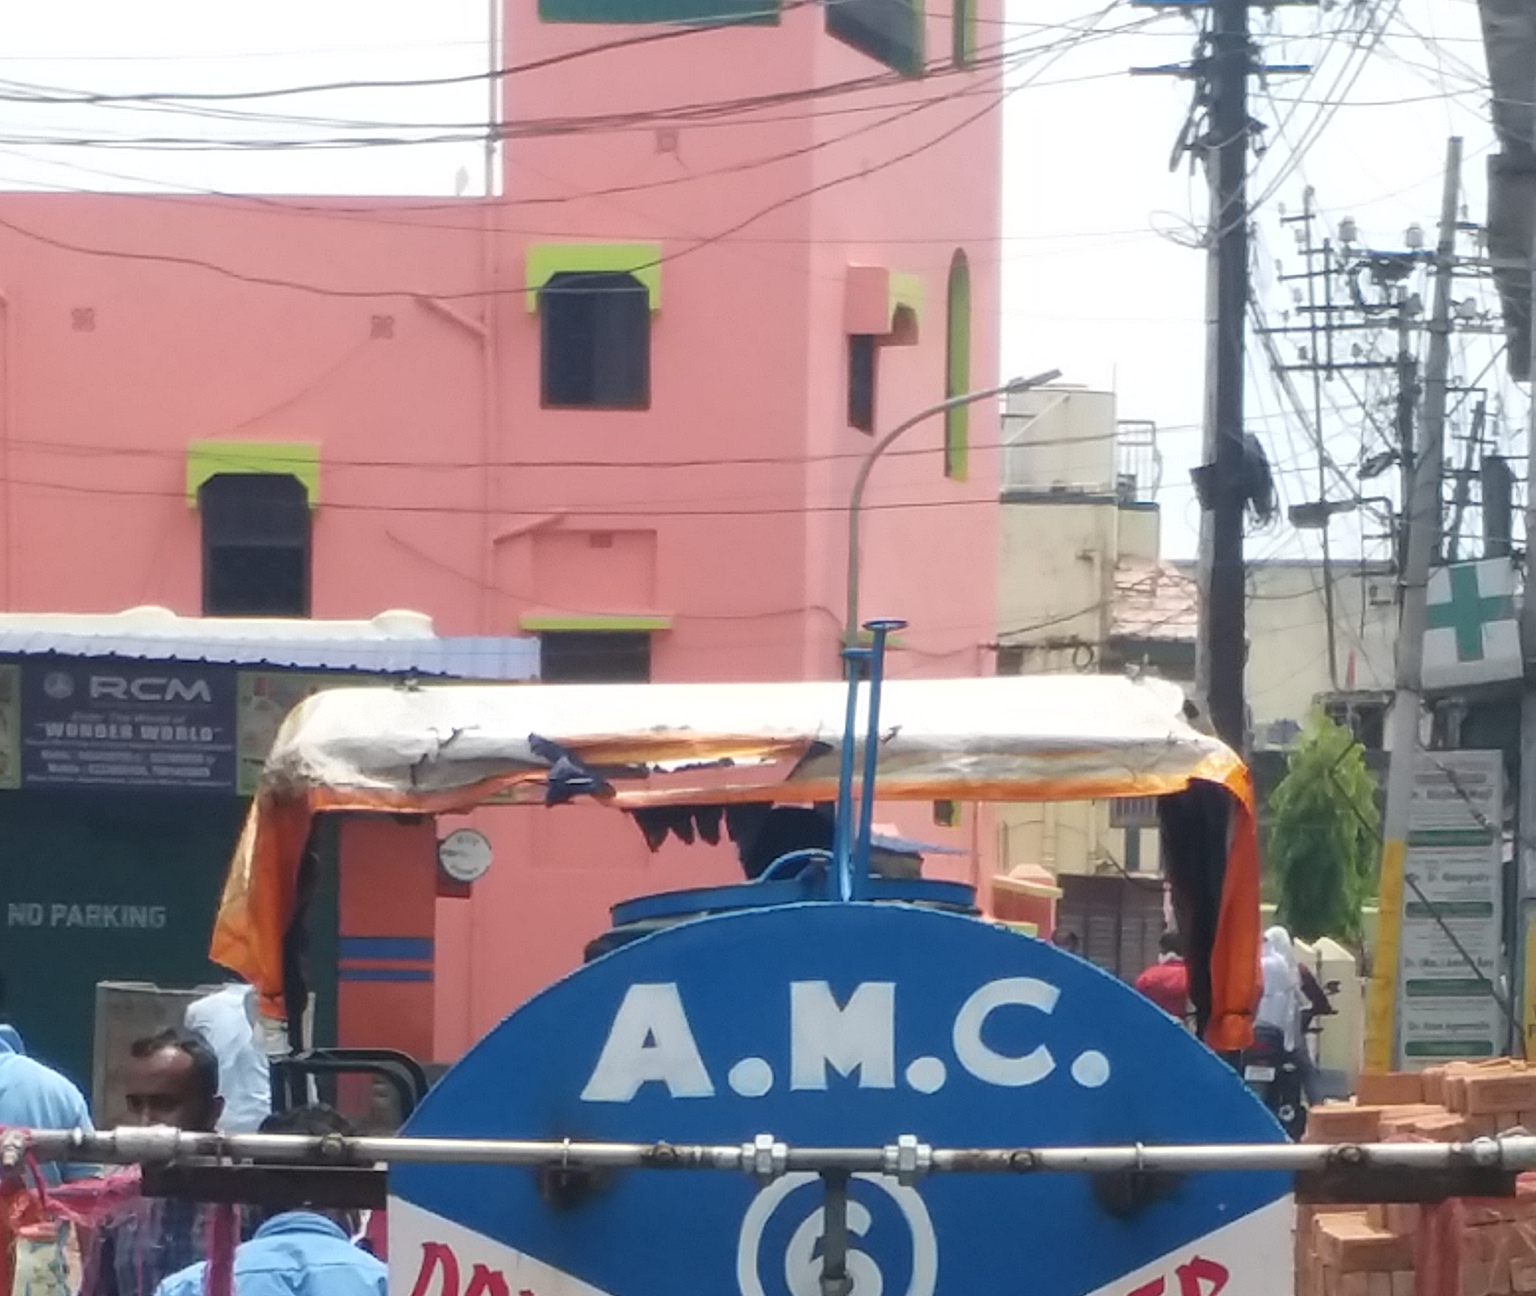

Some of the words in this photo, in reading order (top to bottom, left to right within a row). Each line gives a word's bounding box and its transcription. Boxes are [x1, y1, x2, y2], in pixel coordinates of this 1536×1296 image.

[89, 675, 212, 702] RCM
[8, 903, 43, 927] NO
[50, 903, 166, 928] PARKING
[580, 977, 1110, 1102] A.M.C.
